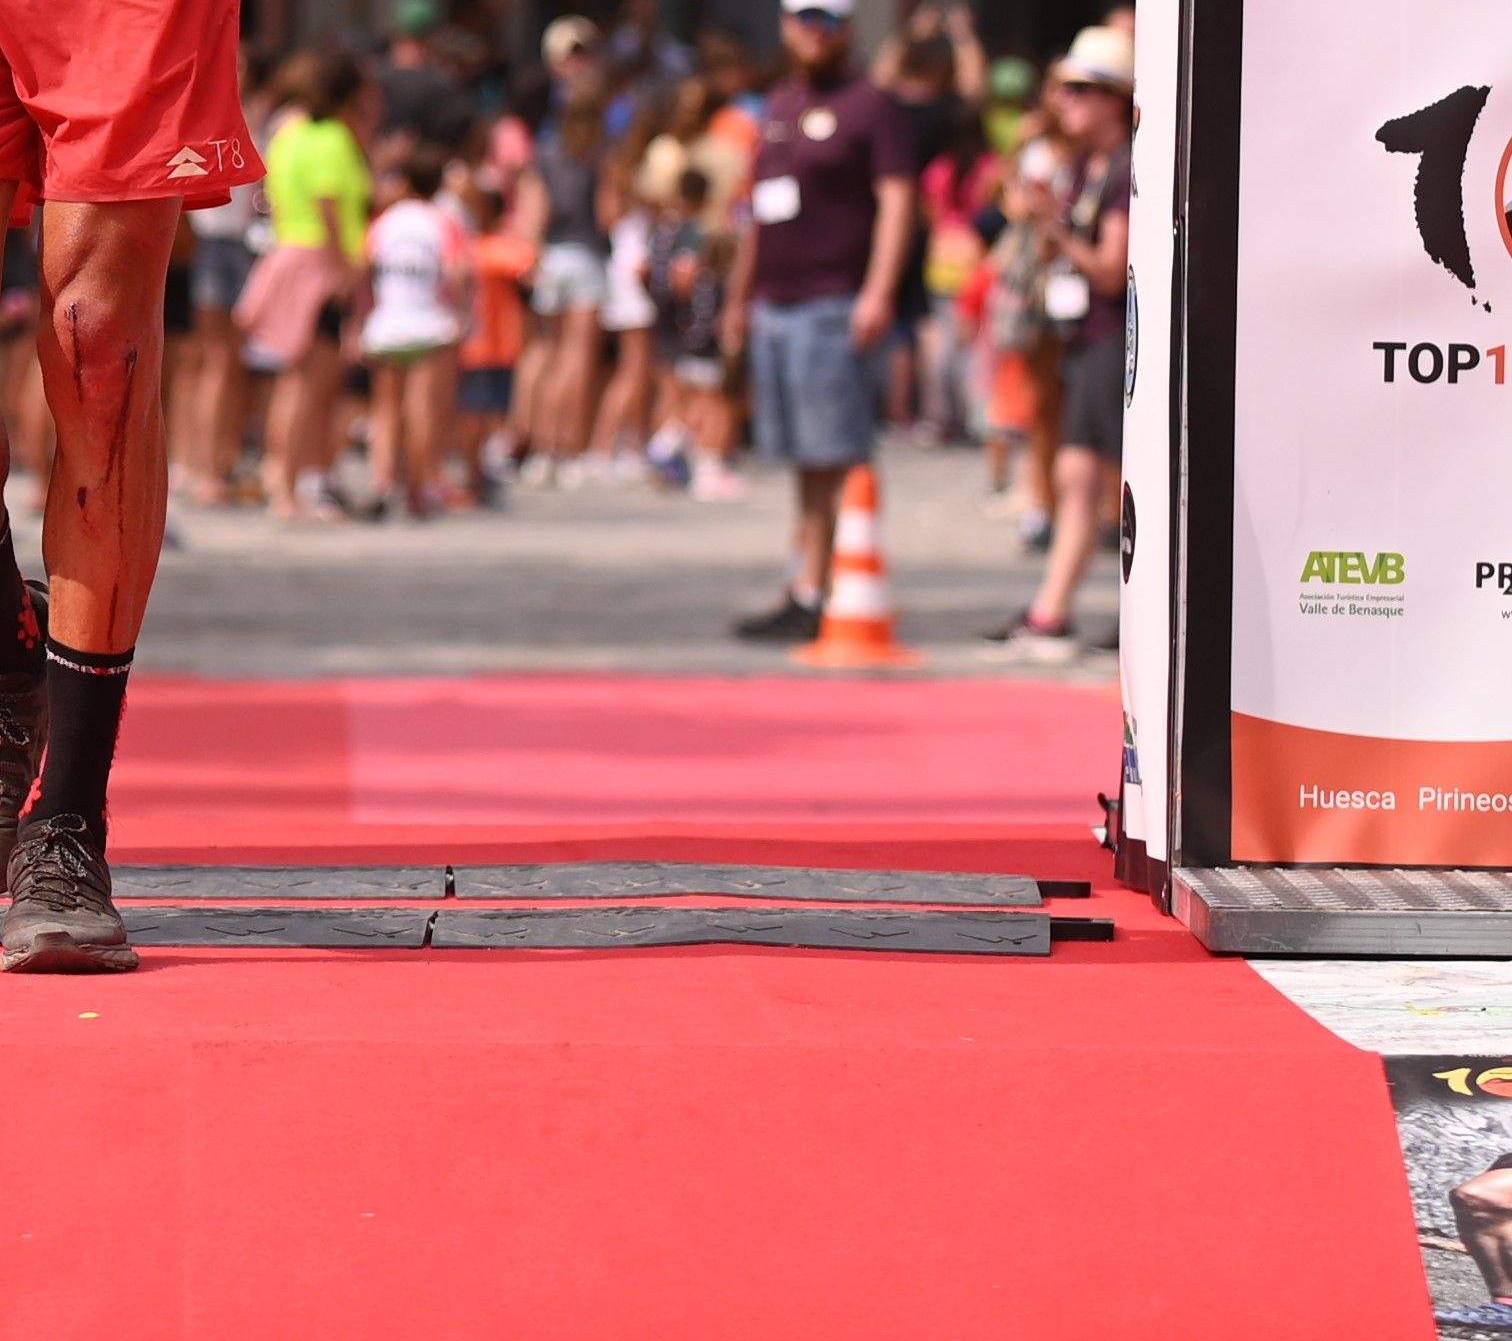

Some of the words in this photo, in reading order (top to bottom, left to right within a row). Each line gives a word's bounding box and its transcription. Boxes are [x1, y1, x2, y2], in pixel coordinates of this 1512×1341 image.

[208, 139, 244, 171] T8
[1299, 551, 1405, 585] ATEVB
[1299, 602, 1328, 615] Valle
[1331, 603, 1346, 616] de
[1349, 603, 1404, 618] Benasque
[1298, 784, 1396, 811] Huesca
